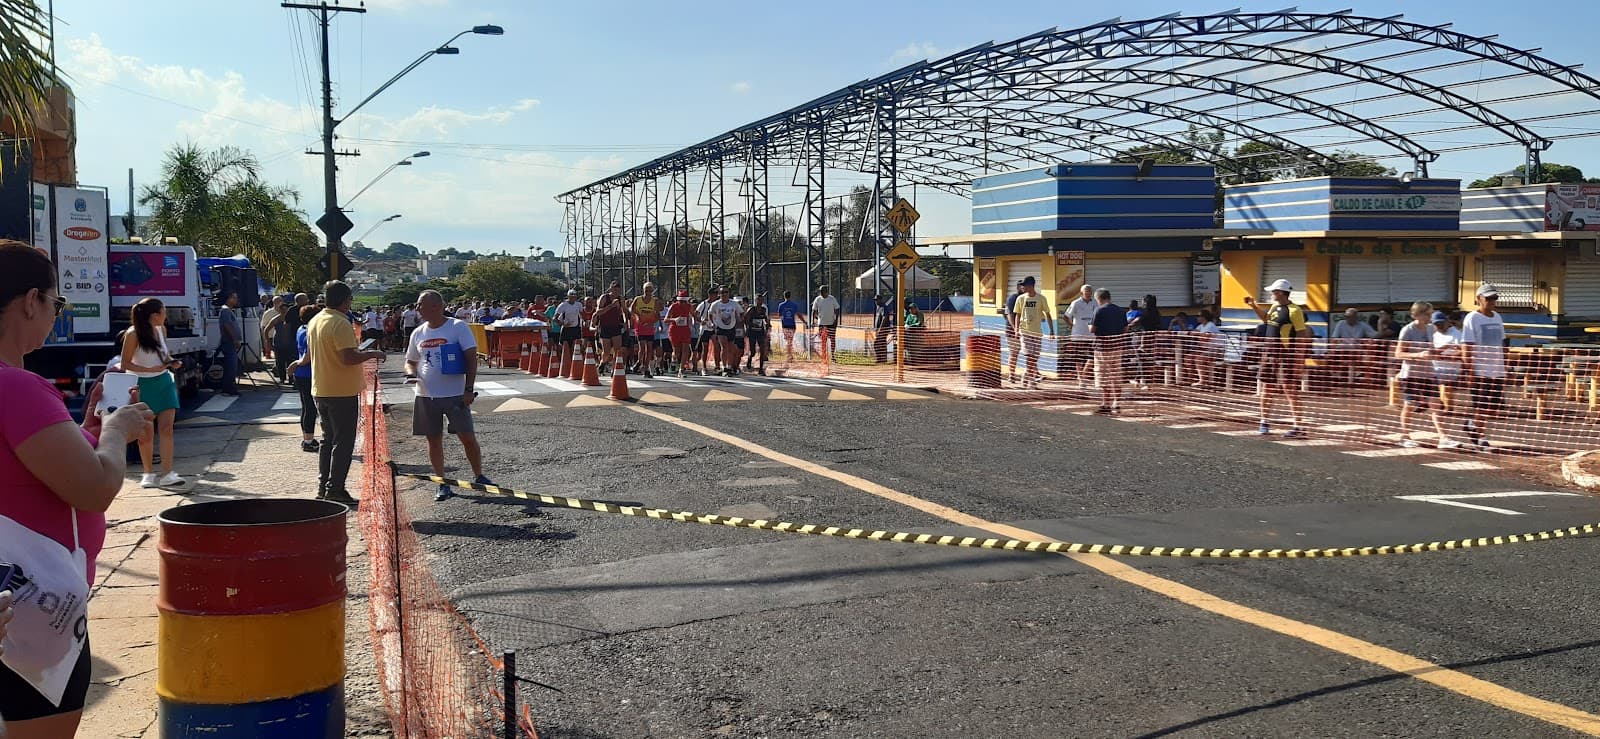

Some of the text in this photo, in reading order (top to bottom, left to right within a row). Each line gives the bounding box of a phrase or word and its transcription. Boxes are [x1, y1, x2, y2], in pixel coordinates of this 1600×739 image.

[1333, 198, 1360, 209] CALDO
[1362, 198, 1373, 209] DE
[1375, 198, 1395, 209] CANA
[1316, 239, 1364, 254] Caldo
